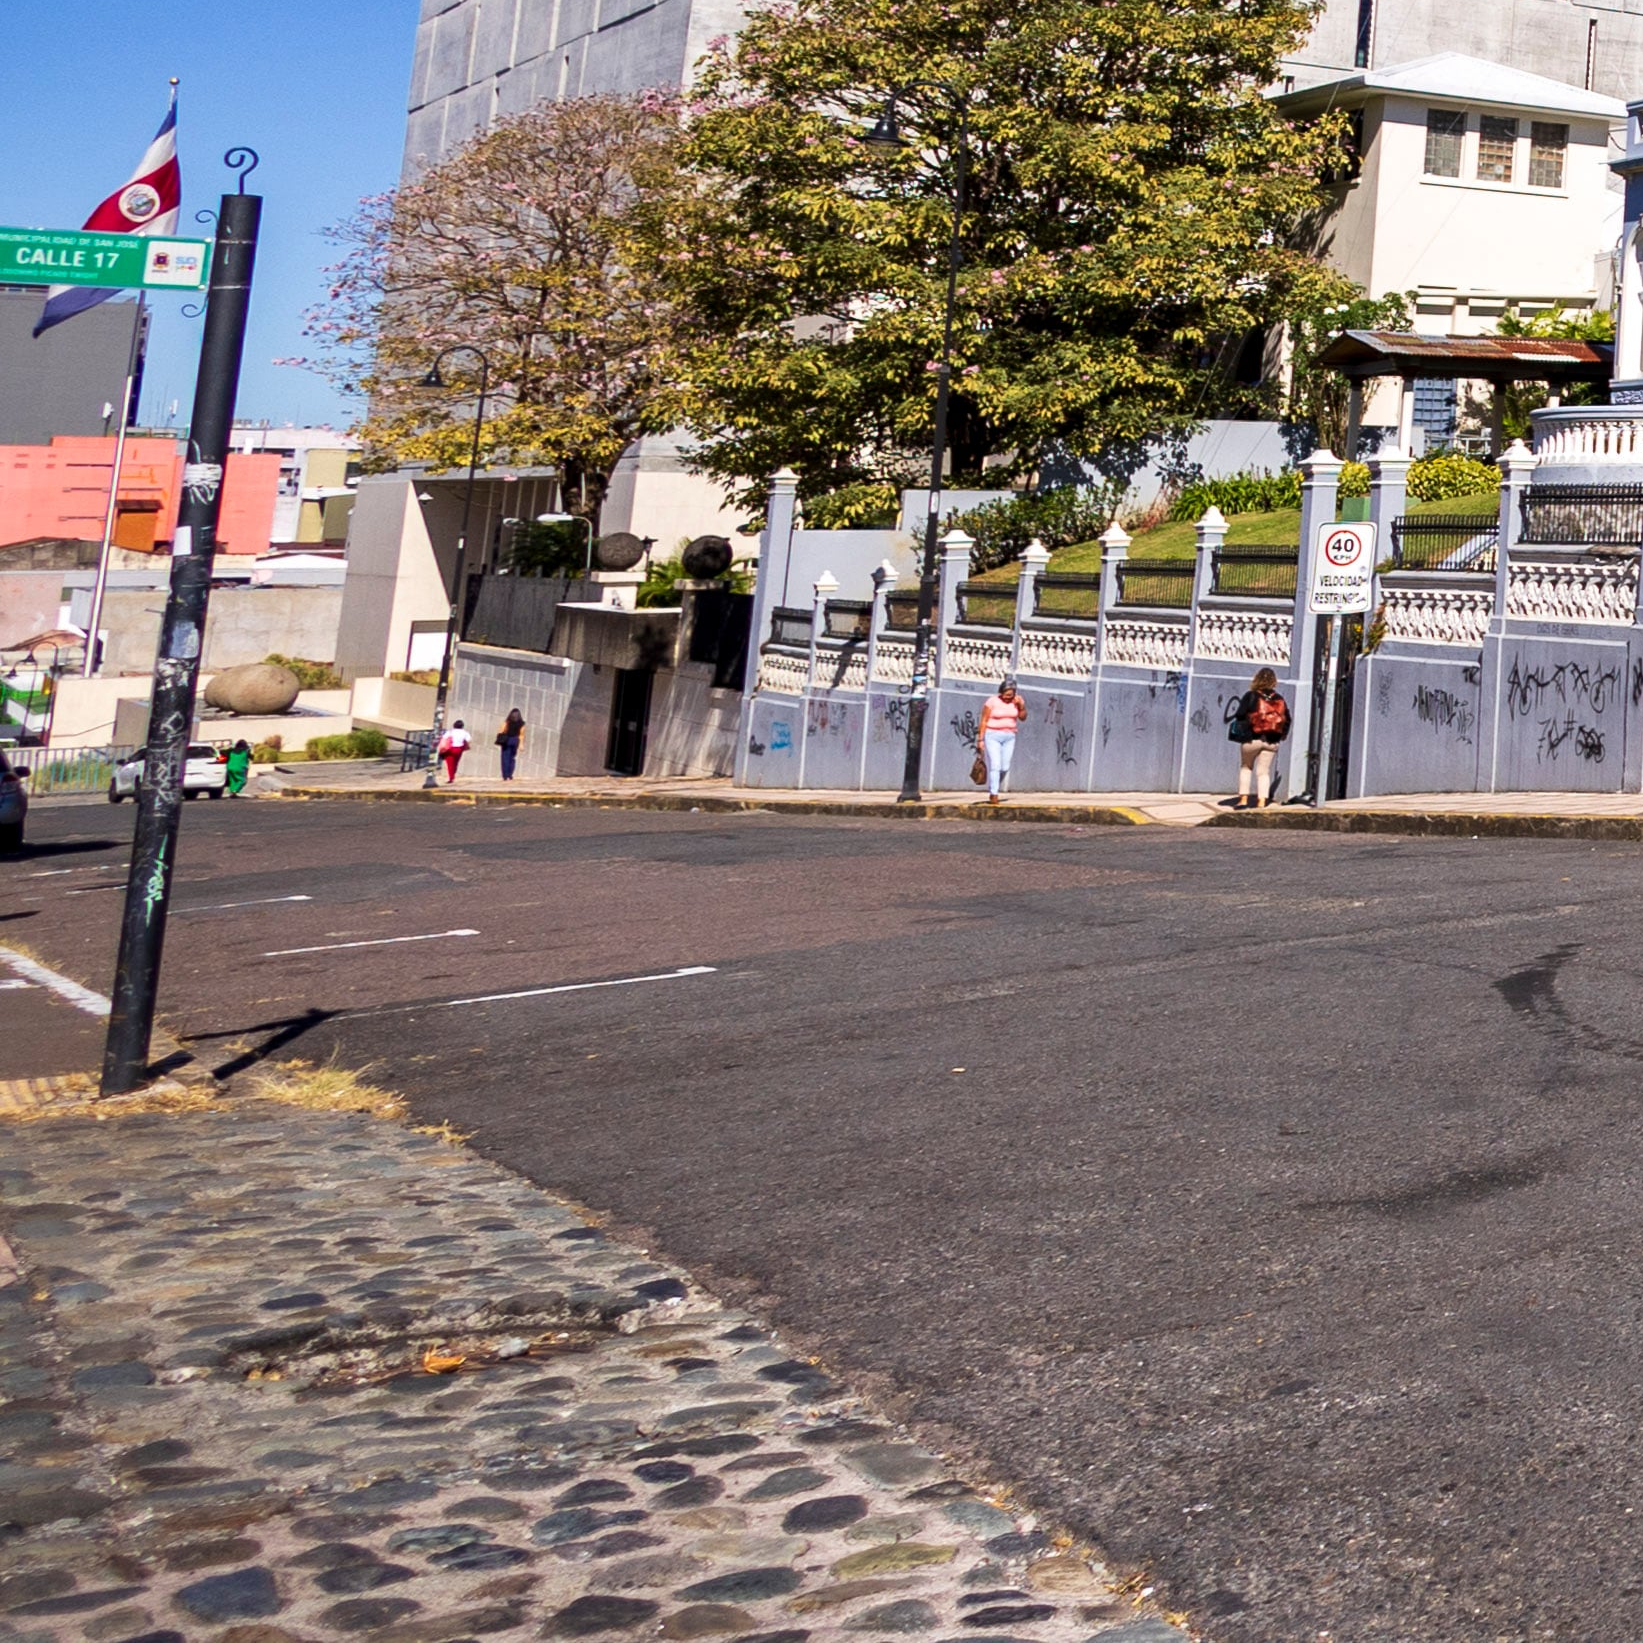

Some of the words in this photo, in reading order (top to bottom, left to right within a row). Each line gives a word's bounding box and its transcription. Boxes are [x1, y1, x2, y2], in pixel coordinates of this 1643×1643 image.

[16, 247, 86, 267] CALLE
[94, 252, 120, 268] 17
[1332, 538, 1354, 552] 40
[1319, 575, 1362, 587] VELOCIDAD
[1314, 592, 1366, 604] RESTRING
